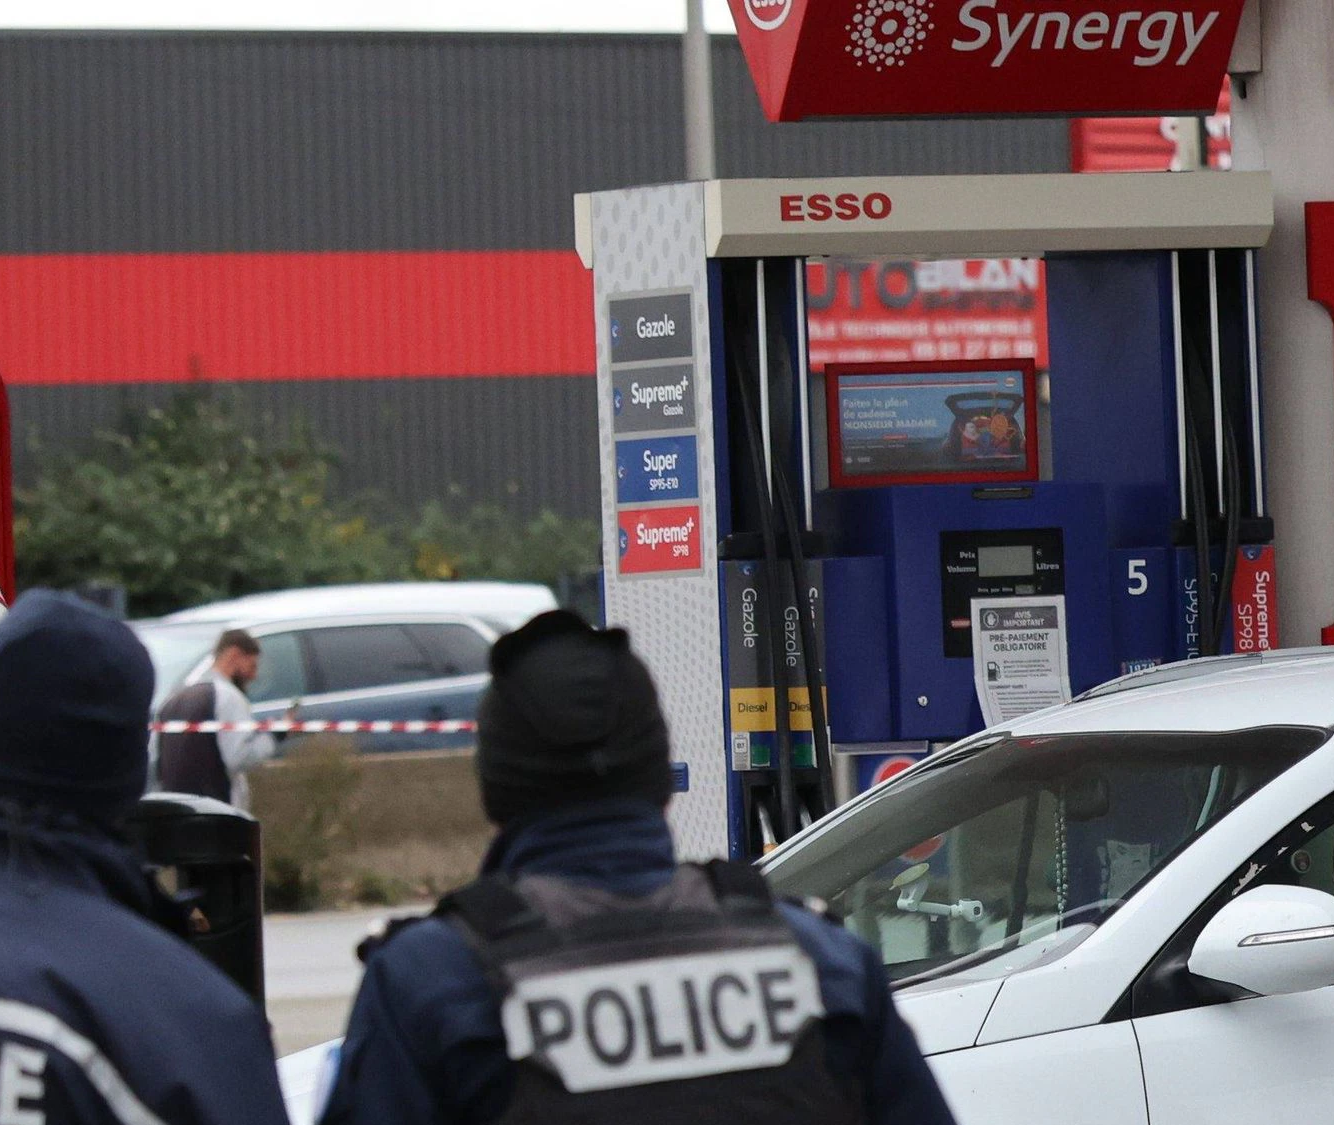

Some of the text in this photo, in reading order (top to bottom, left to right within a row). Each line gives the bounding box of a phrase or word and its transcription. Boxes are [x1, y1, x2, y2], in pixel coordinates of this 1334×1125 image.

[951, 0, 1219, 67] Synergy
[779, 193, 892, 223] ESSO
[806, 258, 917, 310] UTO
[636, 314, 675, 338] Gazole
[663, 403, 684, 417] Gazole
[643, 449, 677, 478] Super
[649, 476, 679, 492] SP95-E10
[673, 543, 689, 557] SP98
[1128, 559, 1148, 596] 5
[741, 587, 759, 649] Gazole
[1237, 603, 1254, 650] SP98
[1251, 570, 1271, 652] Supreme
[784, 605, 801, 668] Gazole
[993, 642, 1047, 652] OBLIGATOIRE
[738, 702, 768, 713] Diesel
[526, 968, 796, 1069] POLICE
